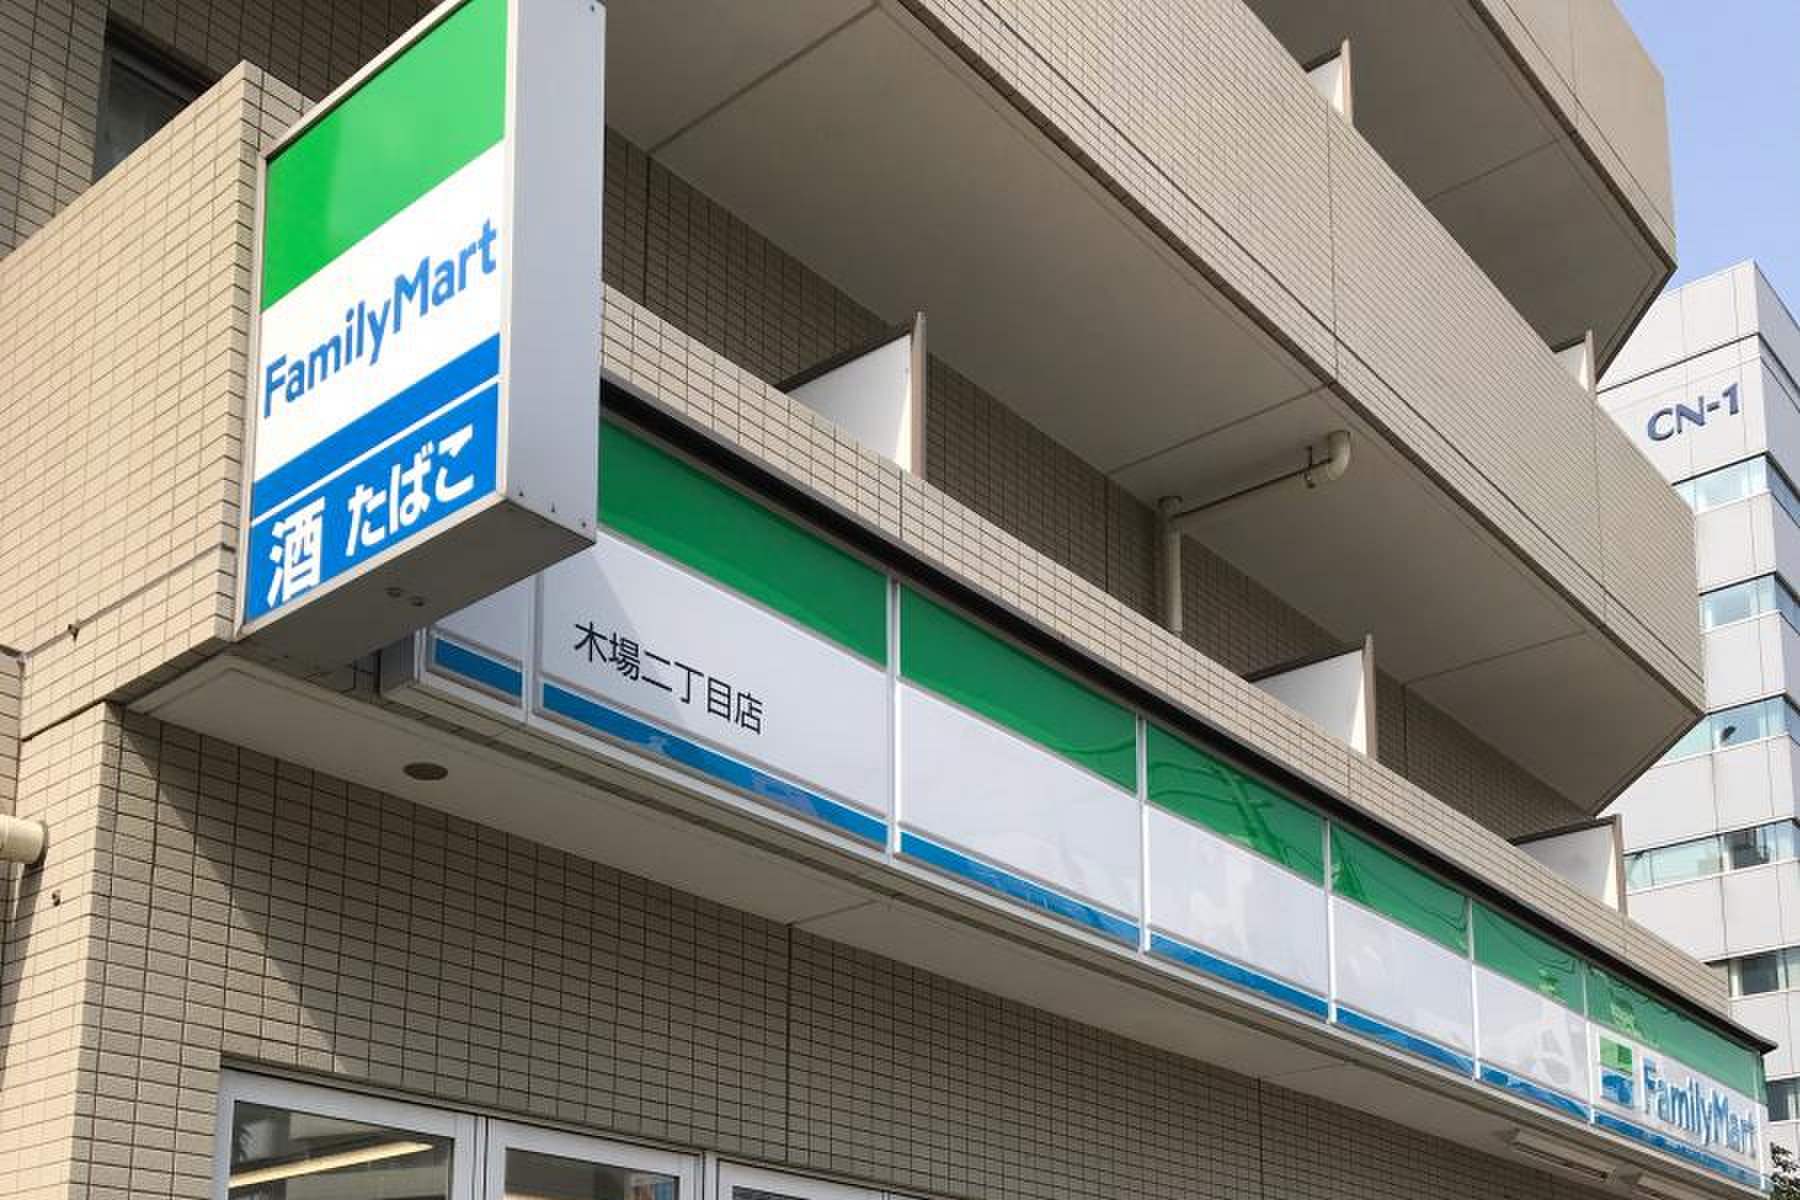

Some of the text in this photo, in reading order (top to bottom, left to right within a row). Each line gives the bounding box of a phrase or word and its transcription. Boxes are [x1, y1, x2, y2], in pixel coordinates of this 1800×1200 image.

[264, 218, 497, 420] FamilyMart
[1647, 383, 1739, 442] CN-1
[267, 424, 474, 608] 酒 たばこ
[574, 621, 763, 736] 木場二丁目店
[1645, 1055, 1756, 1159] FamilyMart
